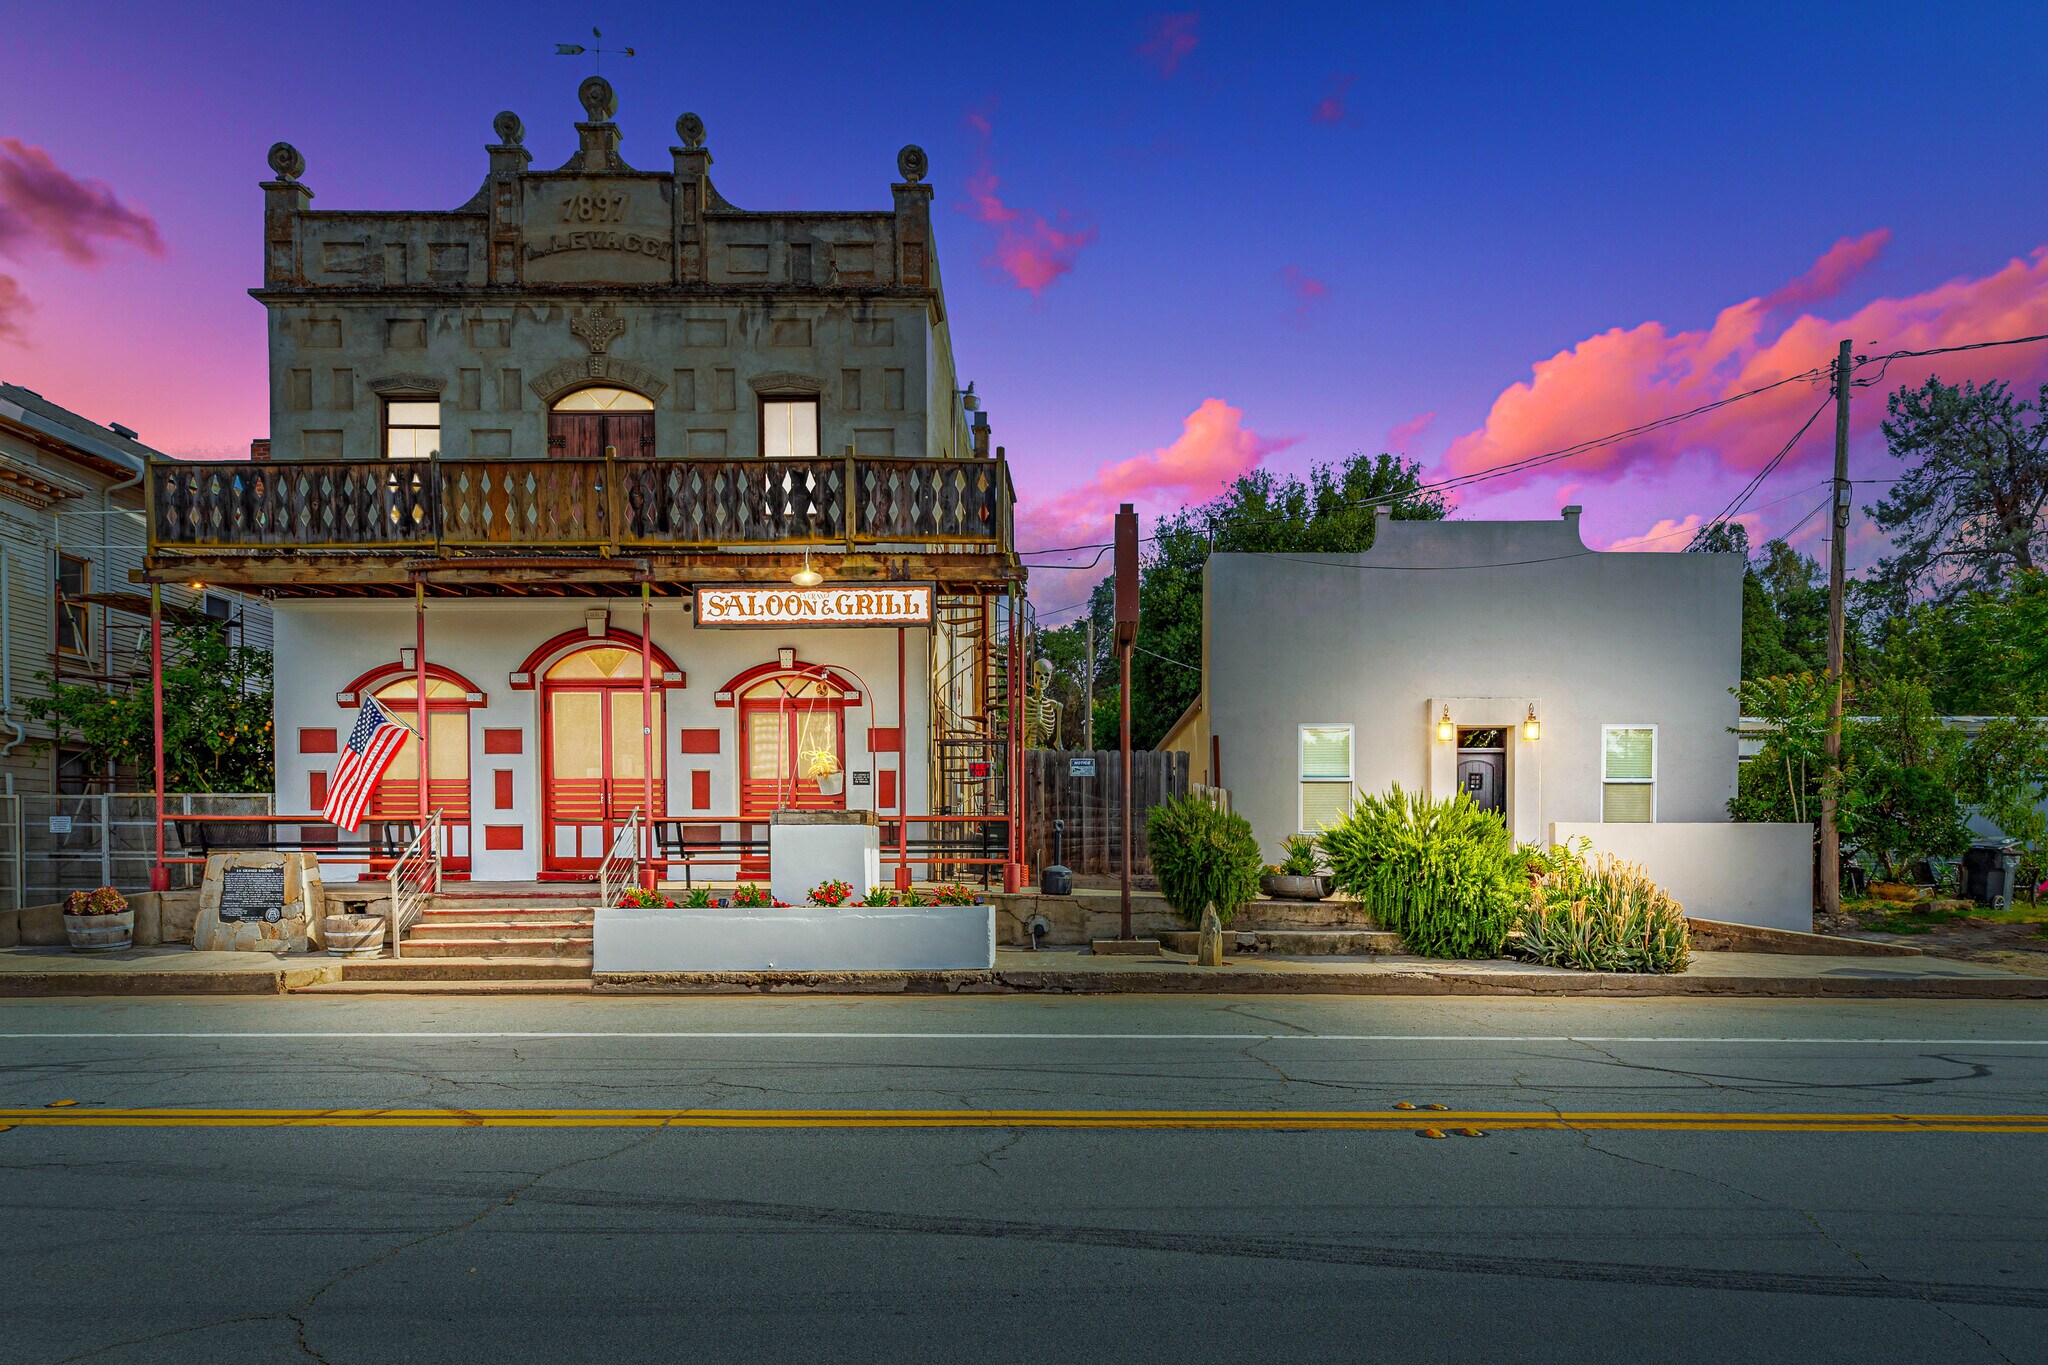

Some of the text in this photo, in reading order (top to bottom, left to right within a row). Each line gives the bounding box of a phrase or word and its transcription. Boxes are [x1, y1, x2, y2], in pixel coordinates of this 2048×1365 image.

[562, 192, 629, 223] 1897
[707, 593, 920, 617] SALOON & GRILL
